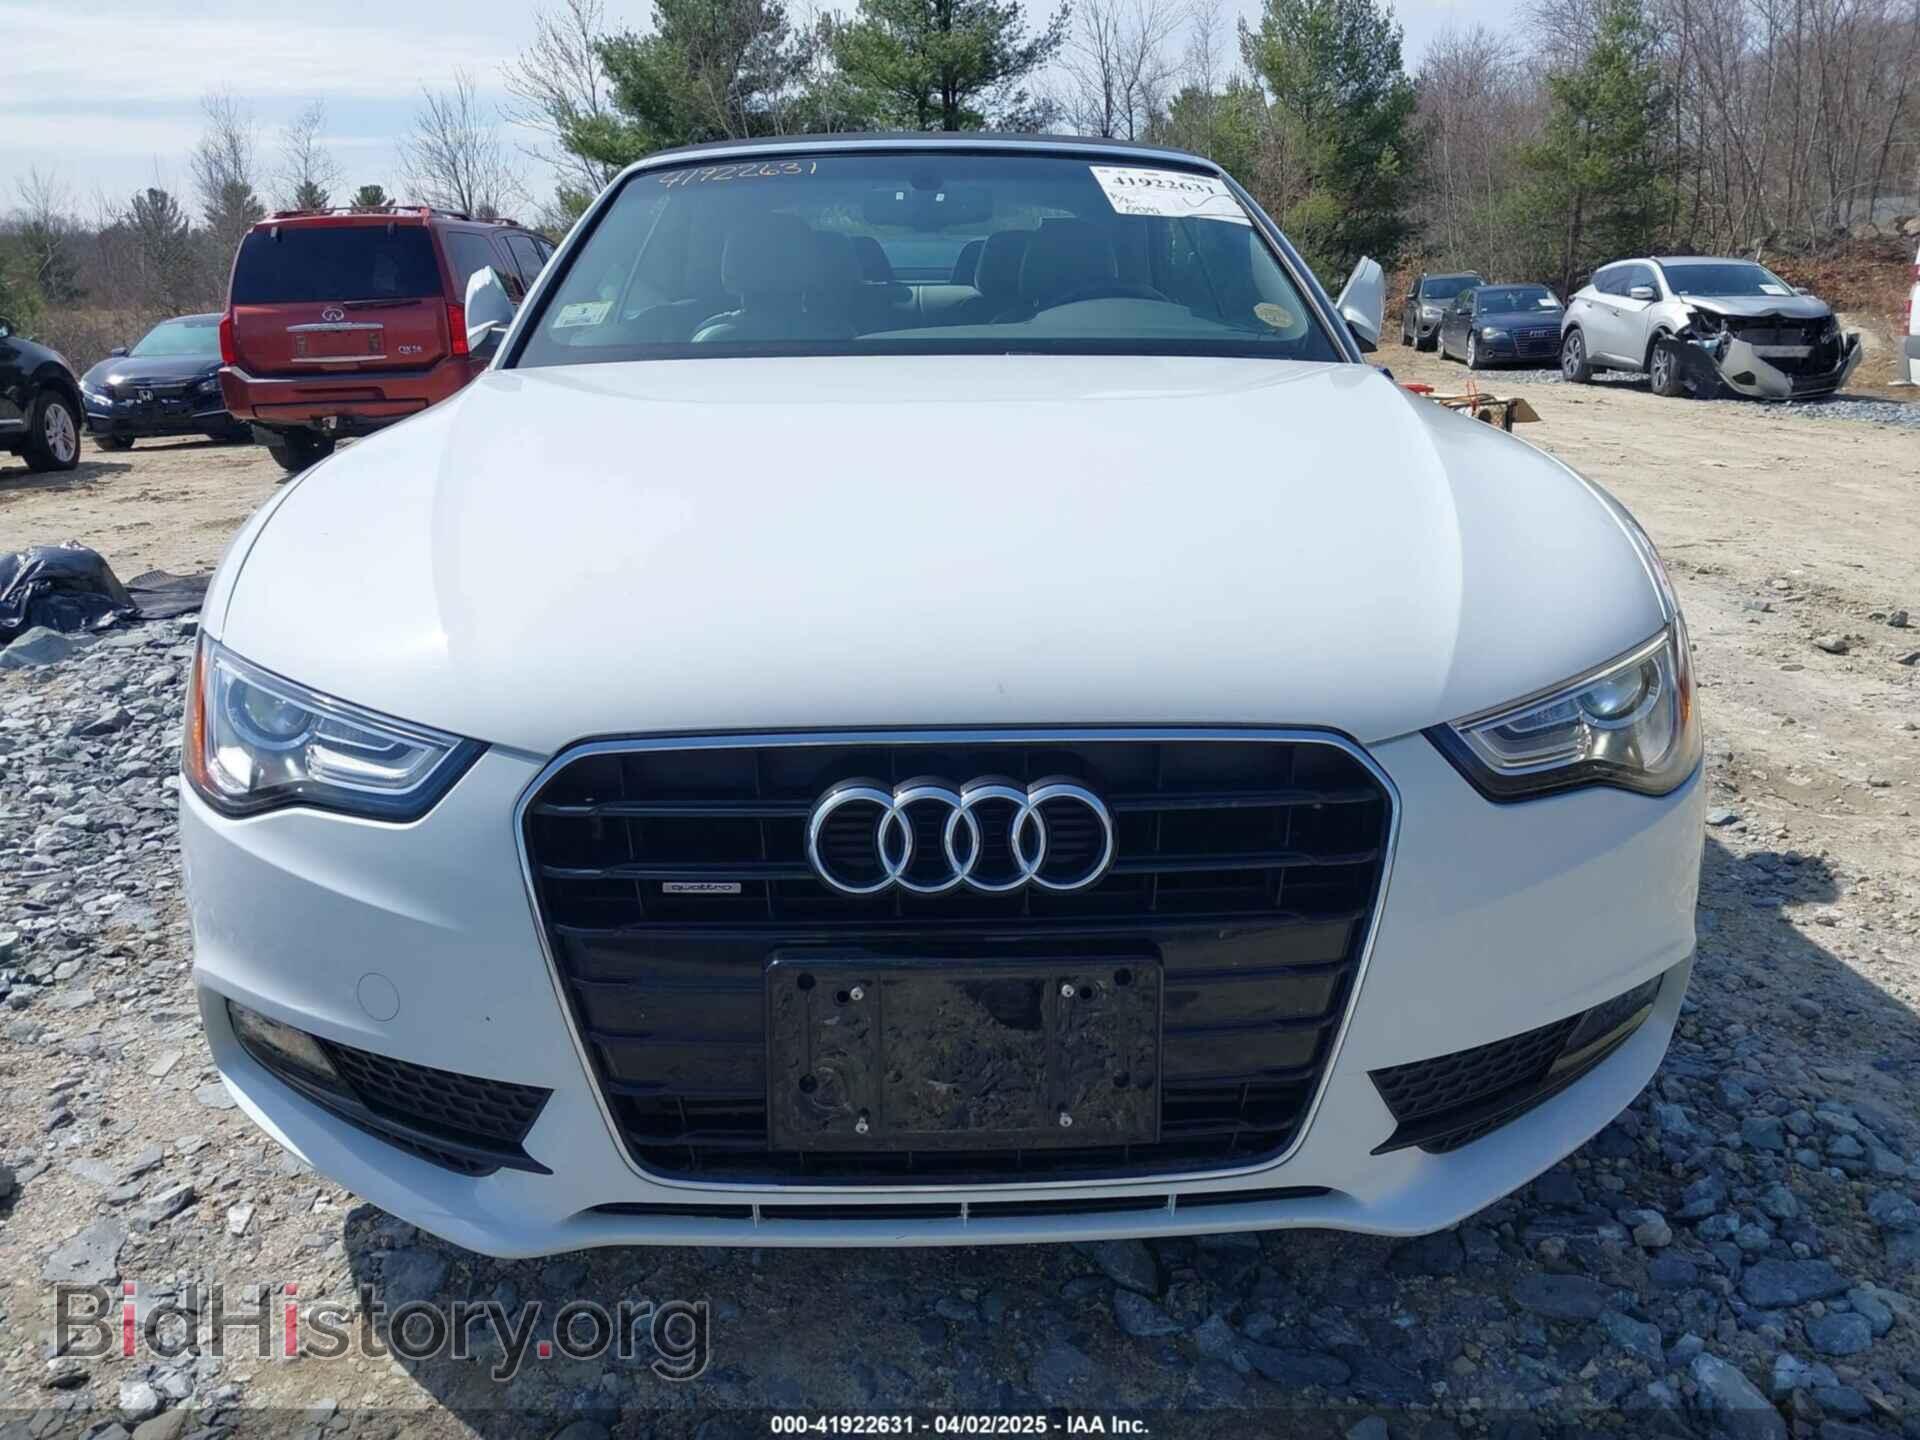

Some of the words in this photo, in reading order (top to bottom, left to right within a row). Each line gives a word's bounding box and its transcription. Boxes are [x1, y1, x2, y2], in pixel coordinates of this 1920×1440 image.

[659, 161, 817, 188] 41922631
[1113, 176, 1216, 195] 41922631
[671, 883, 733, 892] quattro
